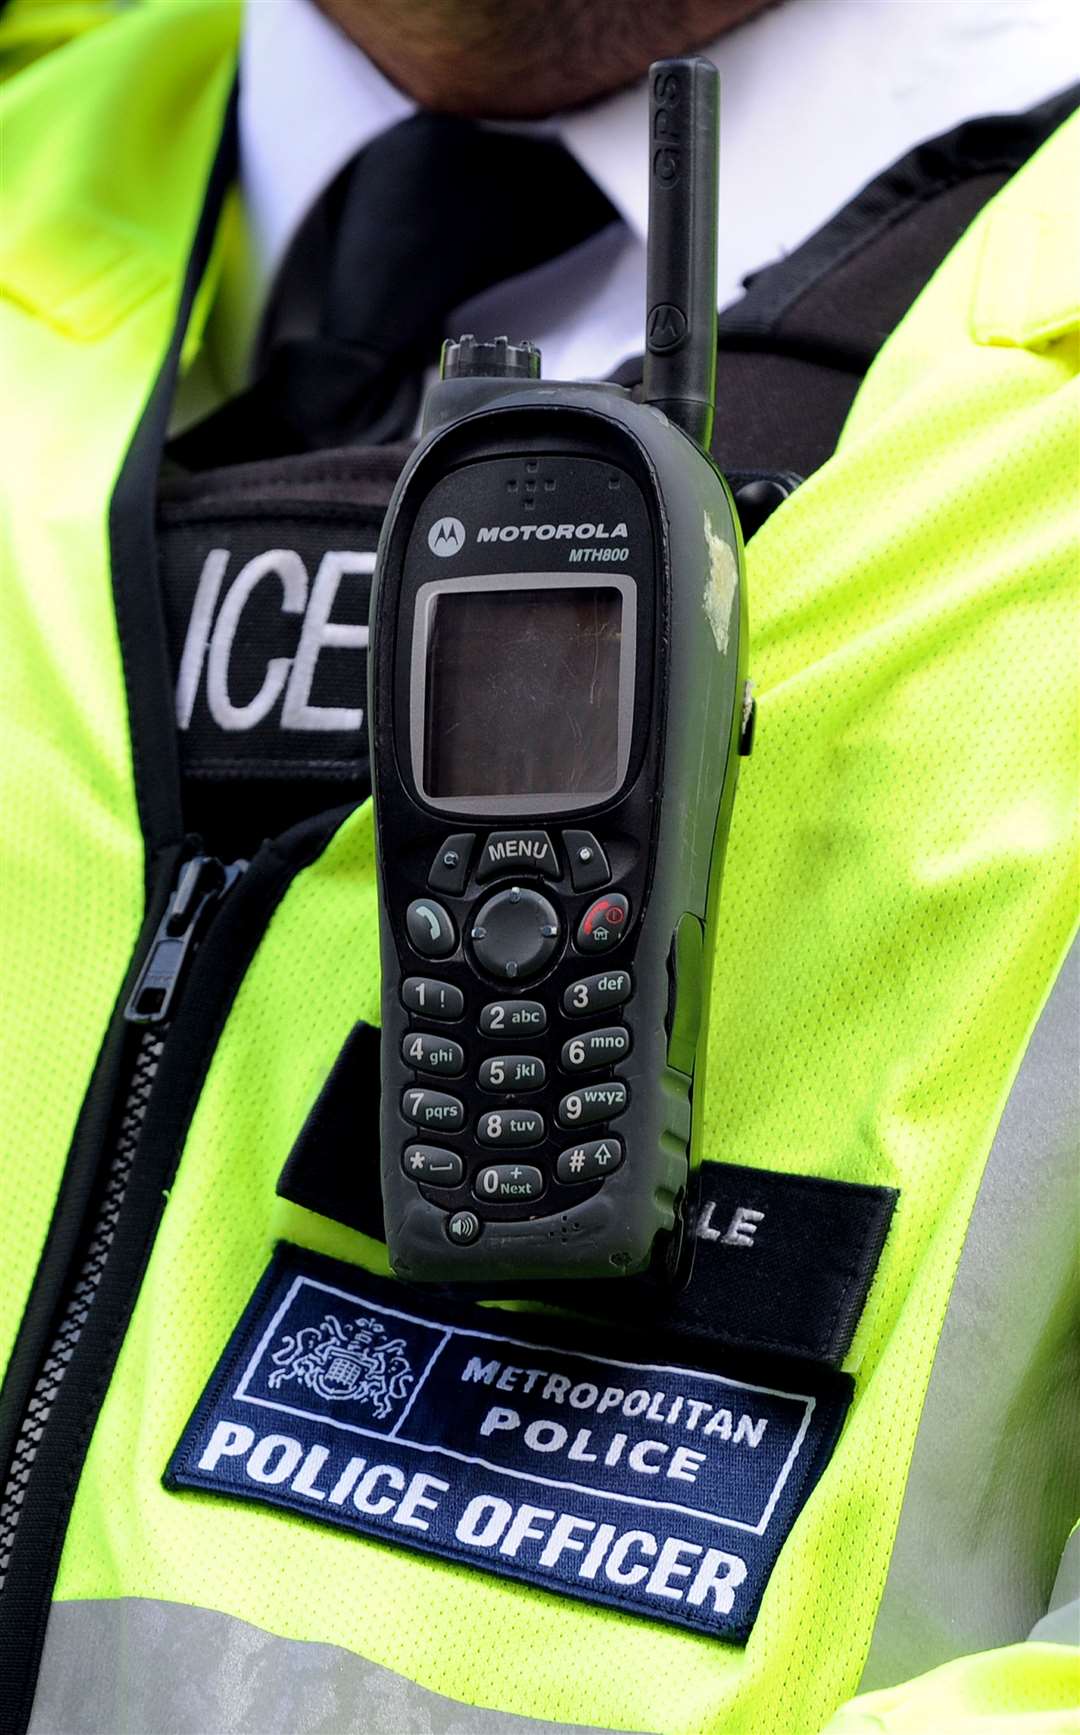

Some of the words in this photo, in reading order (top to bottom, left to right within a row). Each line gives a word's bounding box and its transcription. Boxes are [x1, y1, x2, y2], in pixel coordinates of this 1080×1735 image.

[652, 72, 683, 190] GPS
[476, 523, 629, 543] MOTOROLA
[568, 547, 629, 563] MTH800
[488, 840, 548, 862] MENU
[415, 983, 426, 1006] 1
[572, 984, 589, 1008] 3
[598, 976, 624, 991] def
[489, 1006, 505, 1029] 2
[511, 1008, 540, 1023] abc
[409, 1038, 424, 1061] 4
[429, 1048, 453, 1065] ghi
[568, 1040, 585, 1064] 6
[590, 1036, 625, 1048] mno
[489, 1061, 505, 1085] 5
[514, 1063, 536, 1080] jkl
[409, 1093, 425, 1116] 7
[425, 1104, 458, 1121] pqrs
[565, 1095, 582, 1119] 9
[584, 1091, 624, 1105] wxyz
[486, 1114, 502, 1138] 8
[510, 1121, 536, 1131] tuv
[568, 1150, 586, 1173] #
[483, 1170, 499, 1193] 0
[501, 1184, 532, 1194] Next
[461, 1356, 768, 1448] METROPOLITAN
[479, 1406, 708, 1484] POLICE
[198, 1420, 450, 1532] POLICE
[455, 1493, 749, 1616] OFFICER
